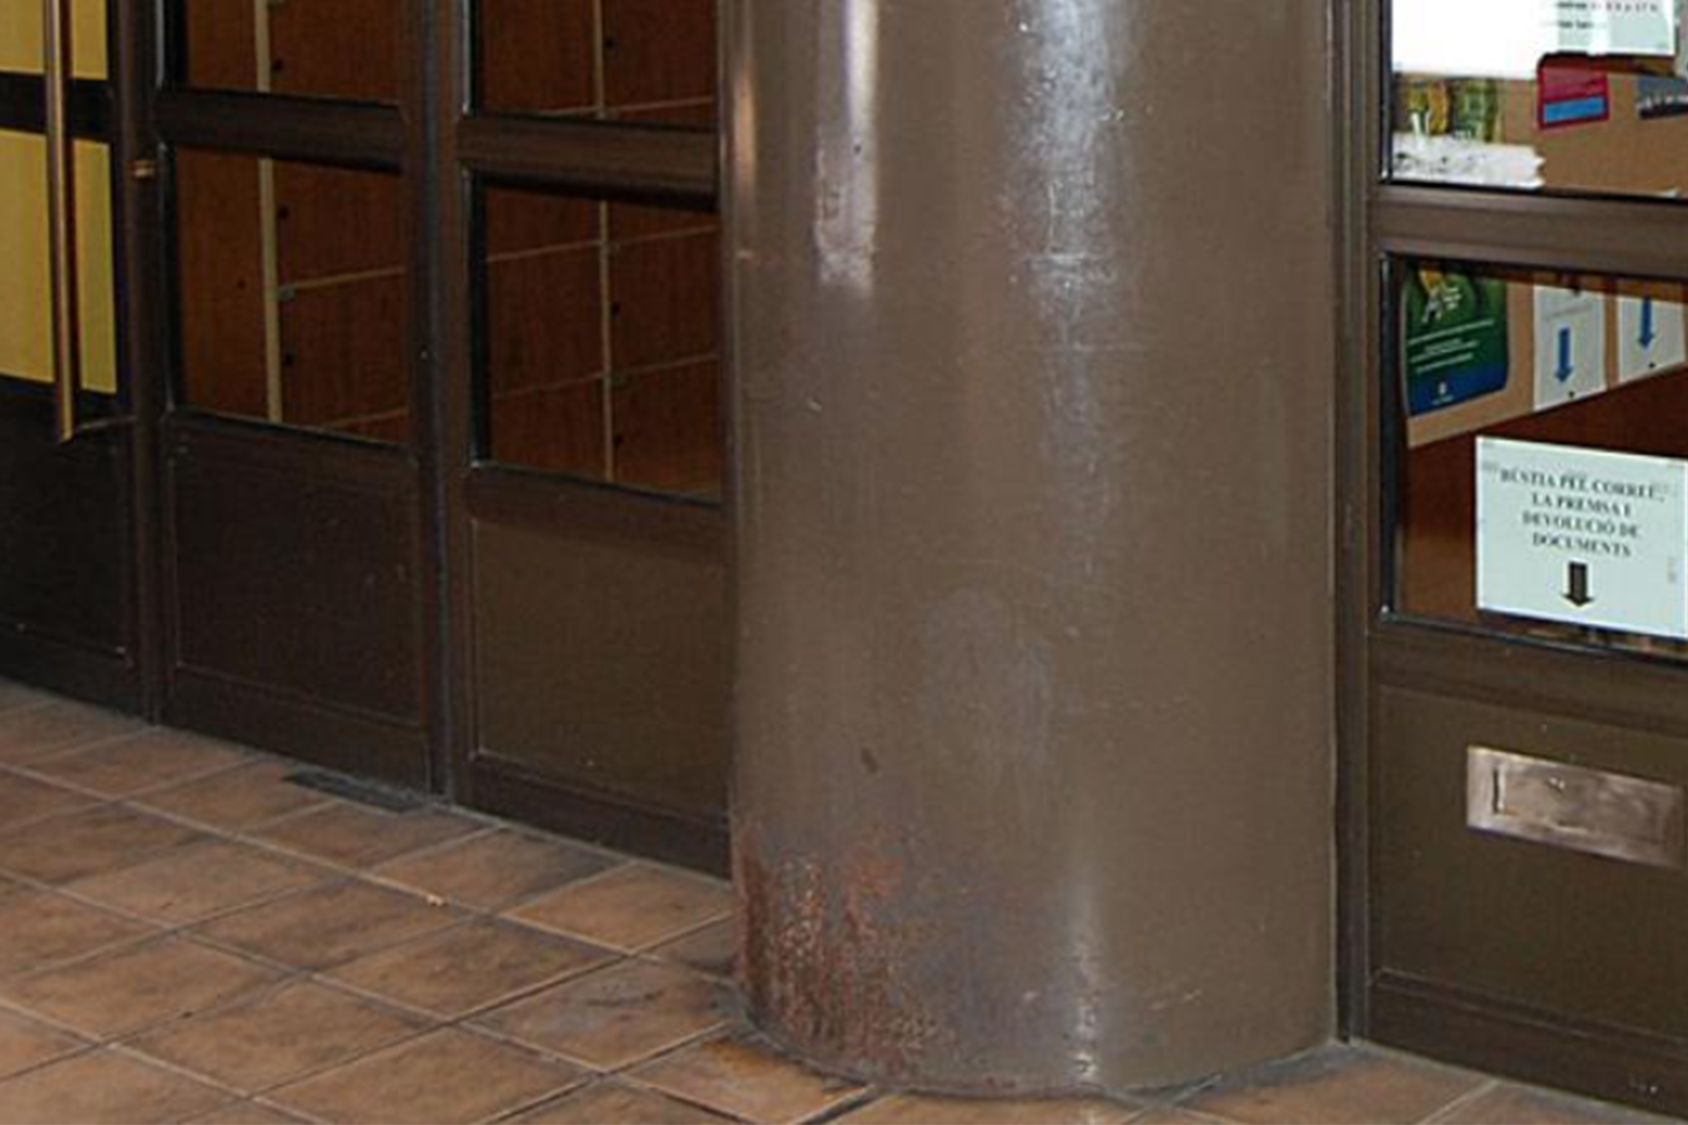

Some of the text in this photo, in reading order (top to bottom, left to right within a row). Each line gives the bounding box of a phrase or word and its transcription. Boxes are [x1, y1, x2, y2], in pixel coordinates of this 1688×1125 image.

[1532, 492, 1631, 518] LA PREMSA I
[1523, 512, 1641, 539] DEVOLUCIÓ DE
[1532, 532, 1632, 558] DOCUMENTS
